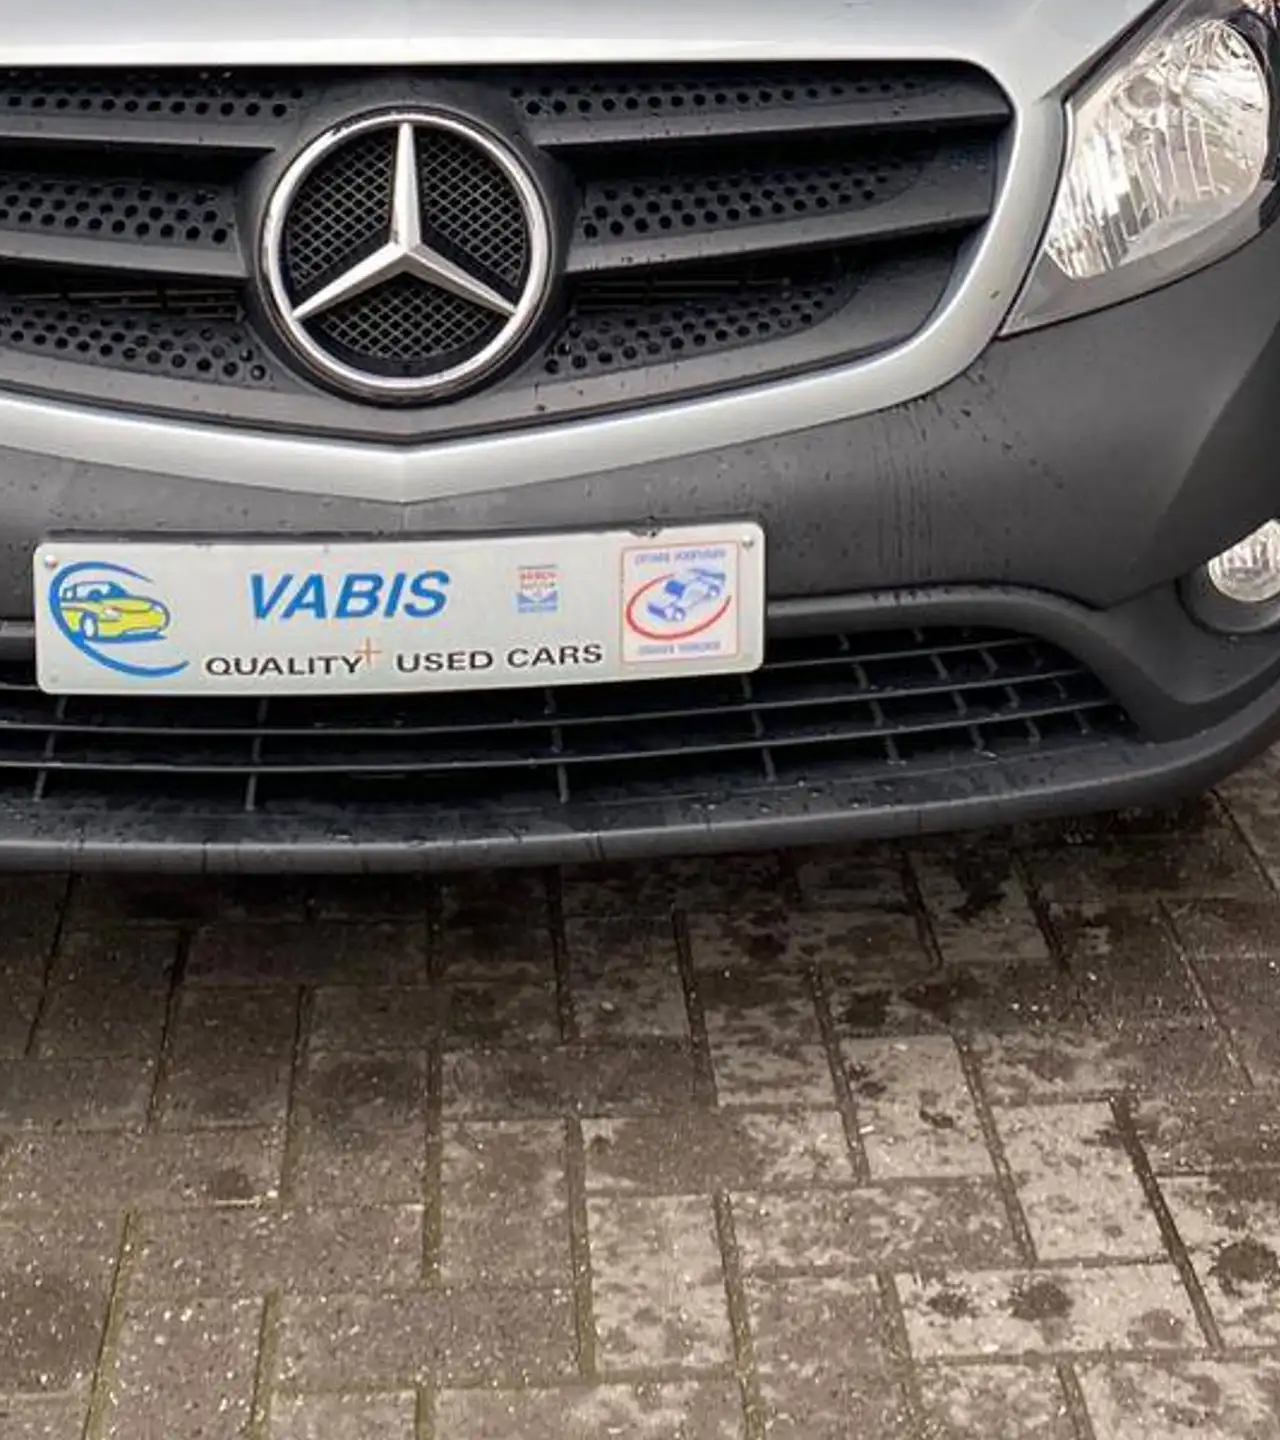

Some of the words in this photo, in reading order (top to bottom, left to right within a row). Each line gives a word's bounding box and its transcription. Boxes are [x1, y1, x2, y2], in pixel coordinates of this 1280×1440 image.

[249, 569, 452, 620] VABIS
[205, 654, 365, 676] QUALITY
[395, 650, 494, 673] USED
[506, 643, 604, 669] CARS
